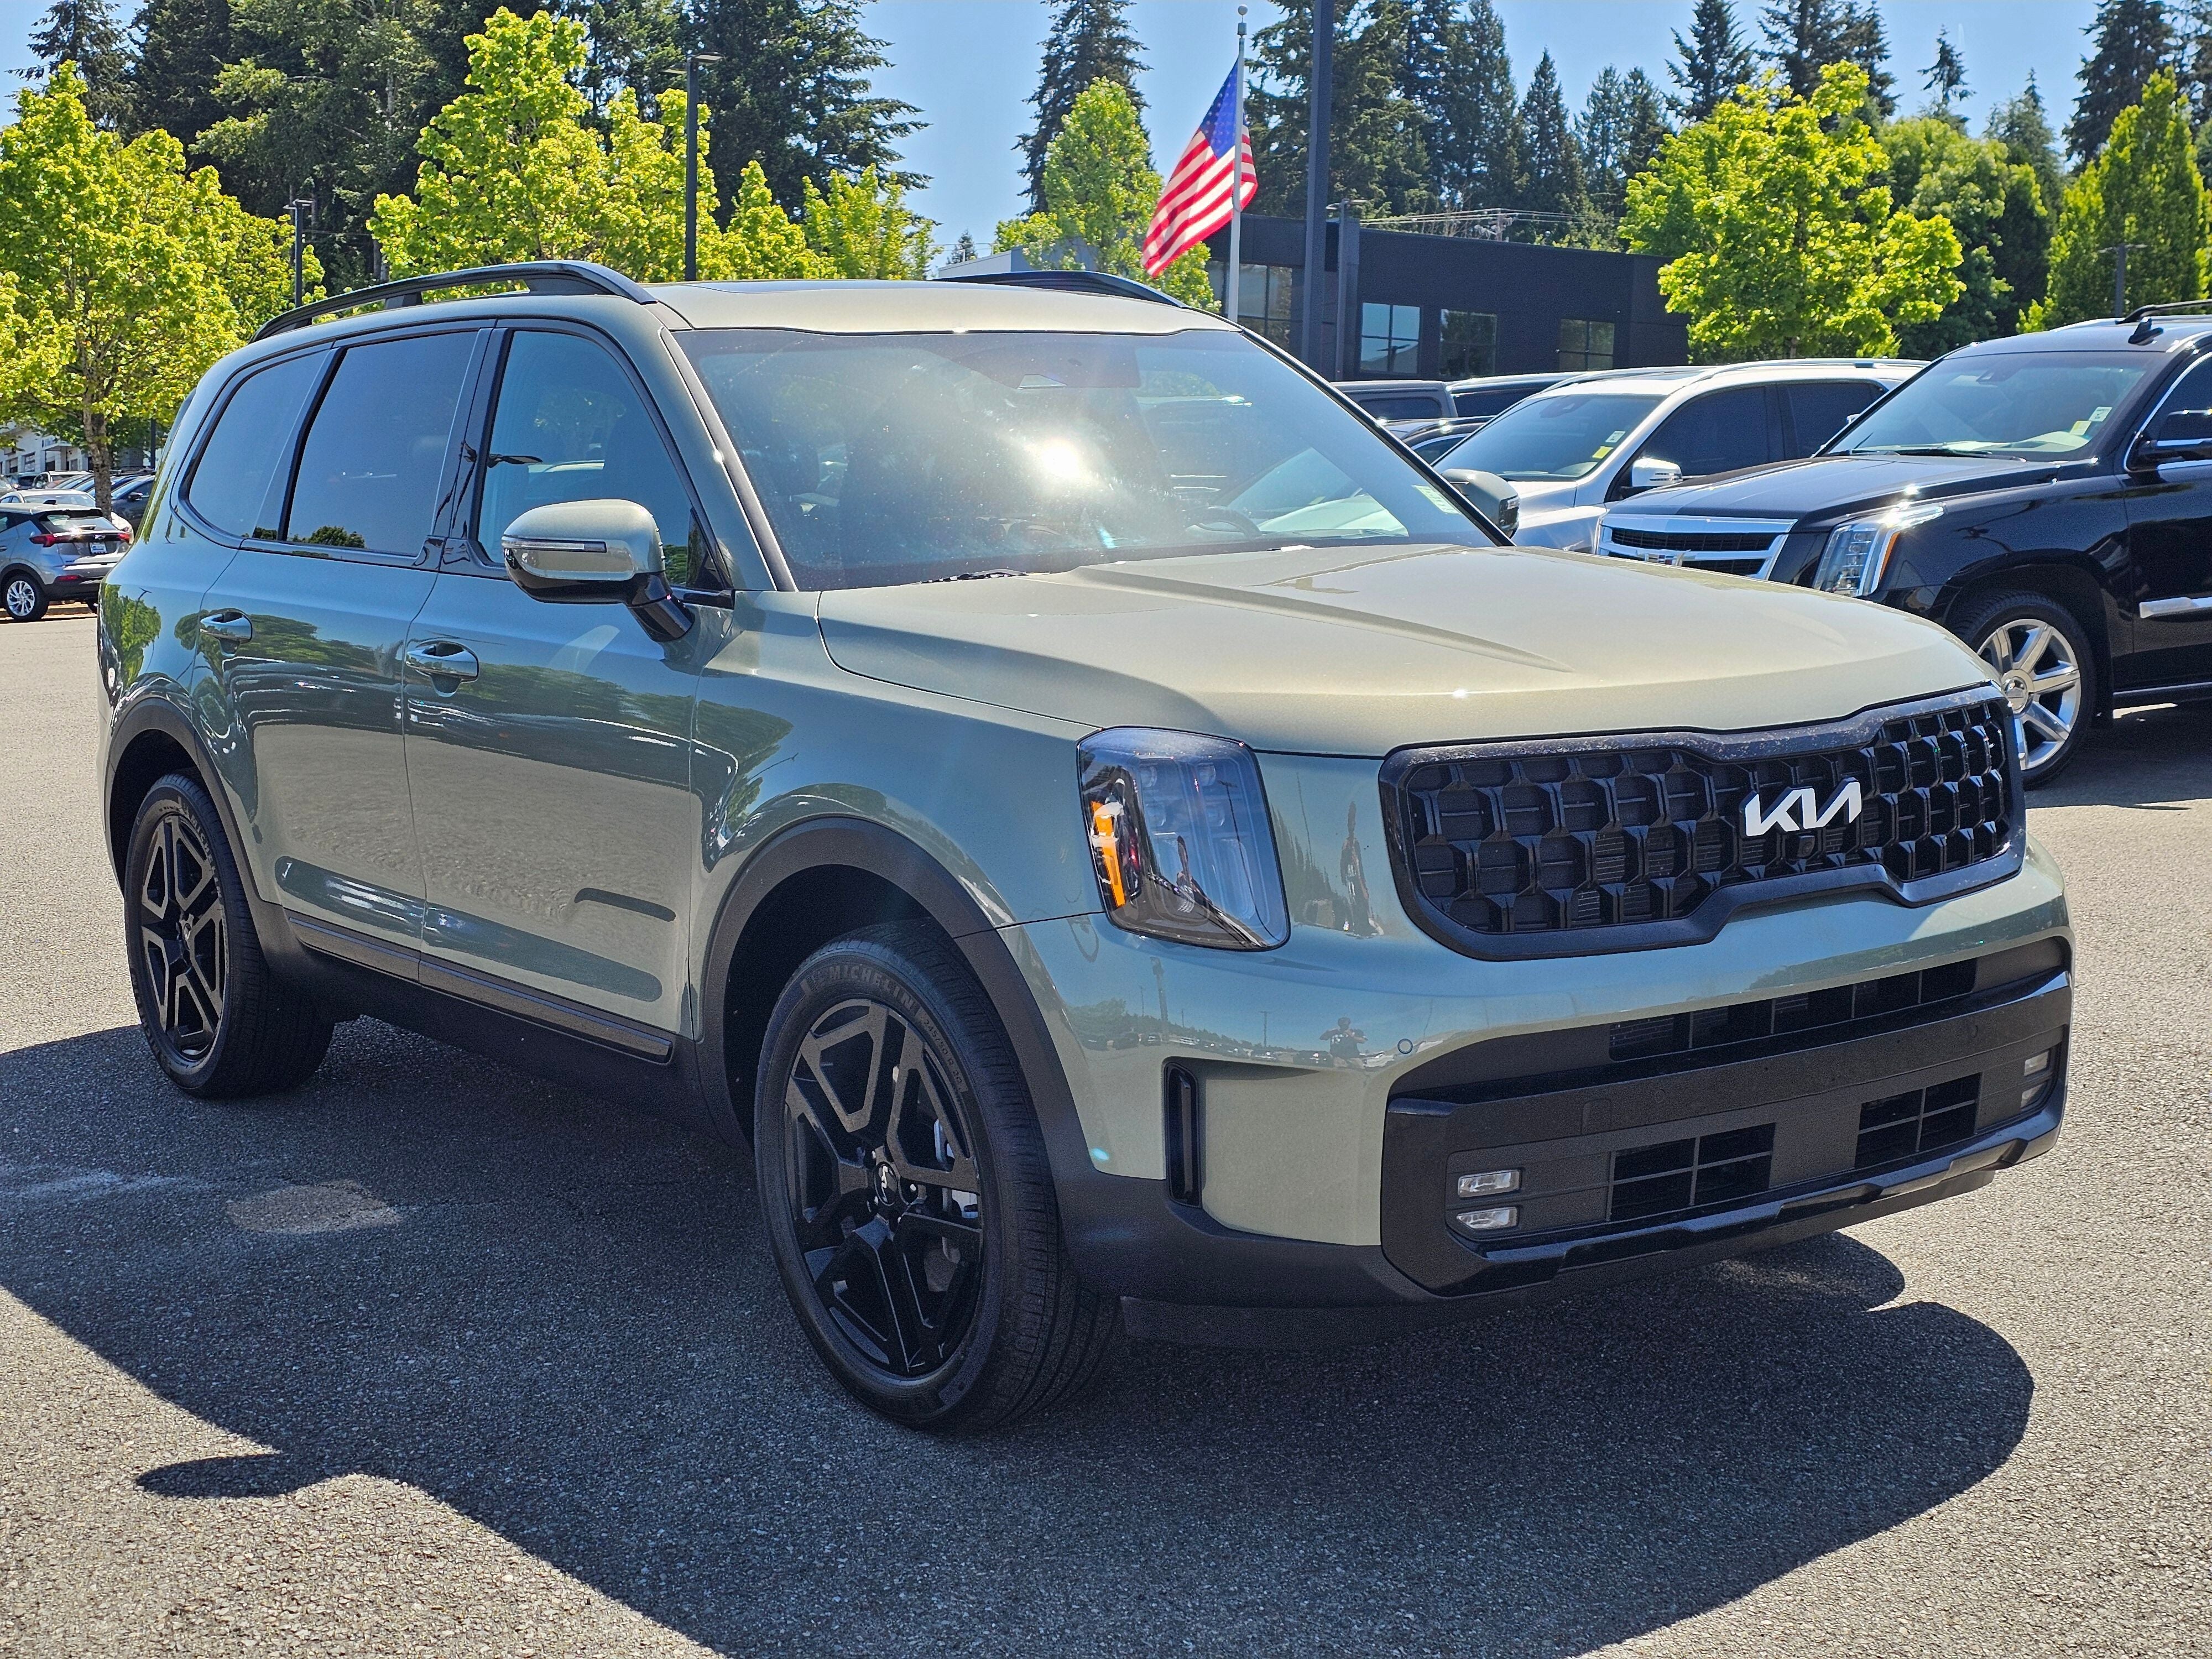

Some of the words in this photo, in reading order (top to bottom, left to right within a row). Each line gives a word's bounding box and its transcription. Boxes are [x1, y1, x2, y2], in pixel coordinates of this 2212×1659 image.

[1743, 778, 1863, 837] KIA
[190, 815, 222, 898] MICHELIN
[829, 965, 915, 1010] MICHELIN
